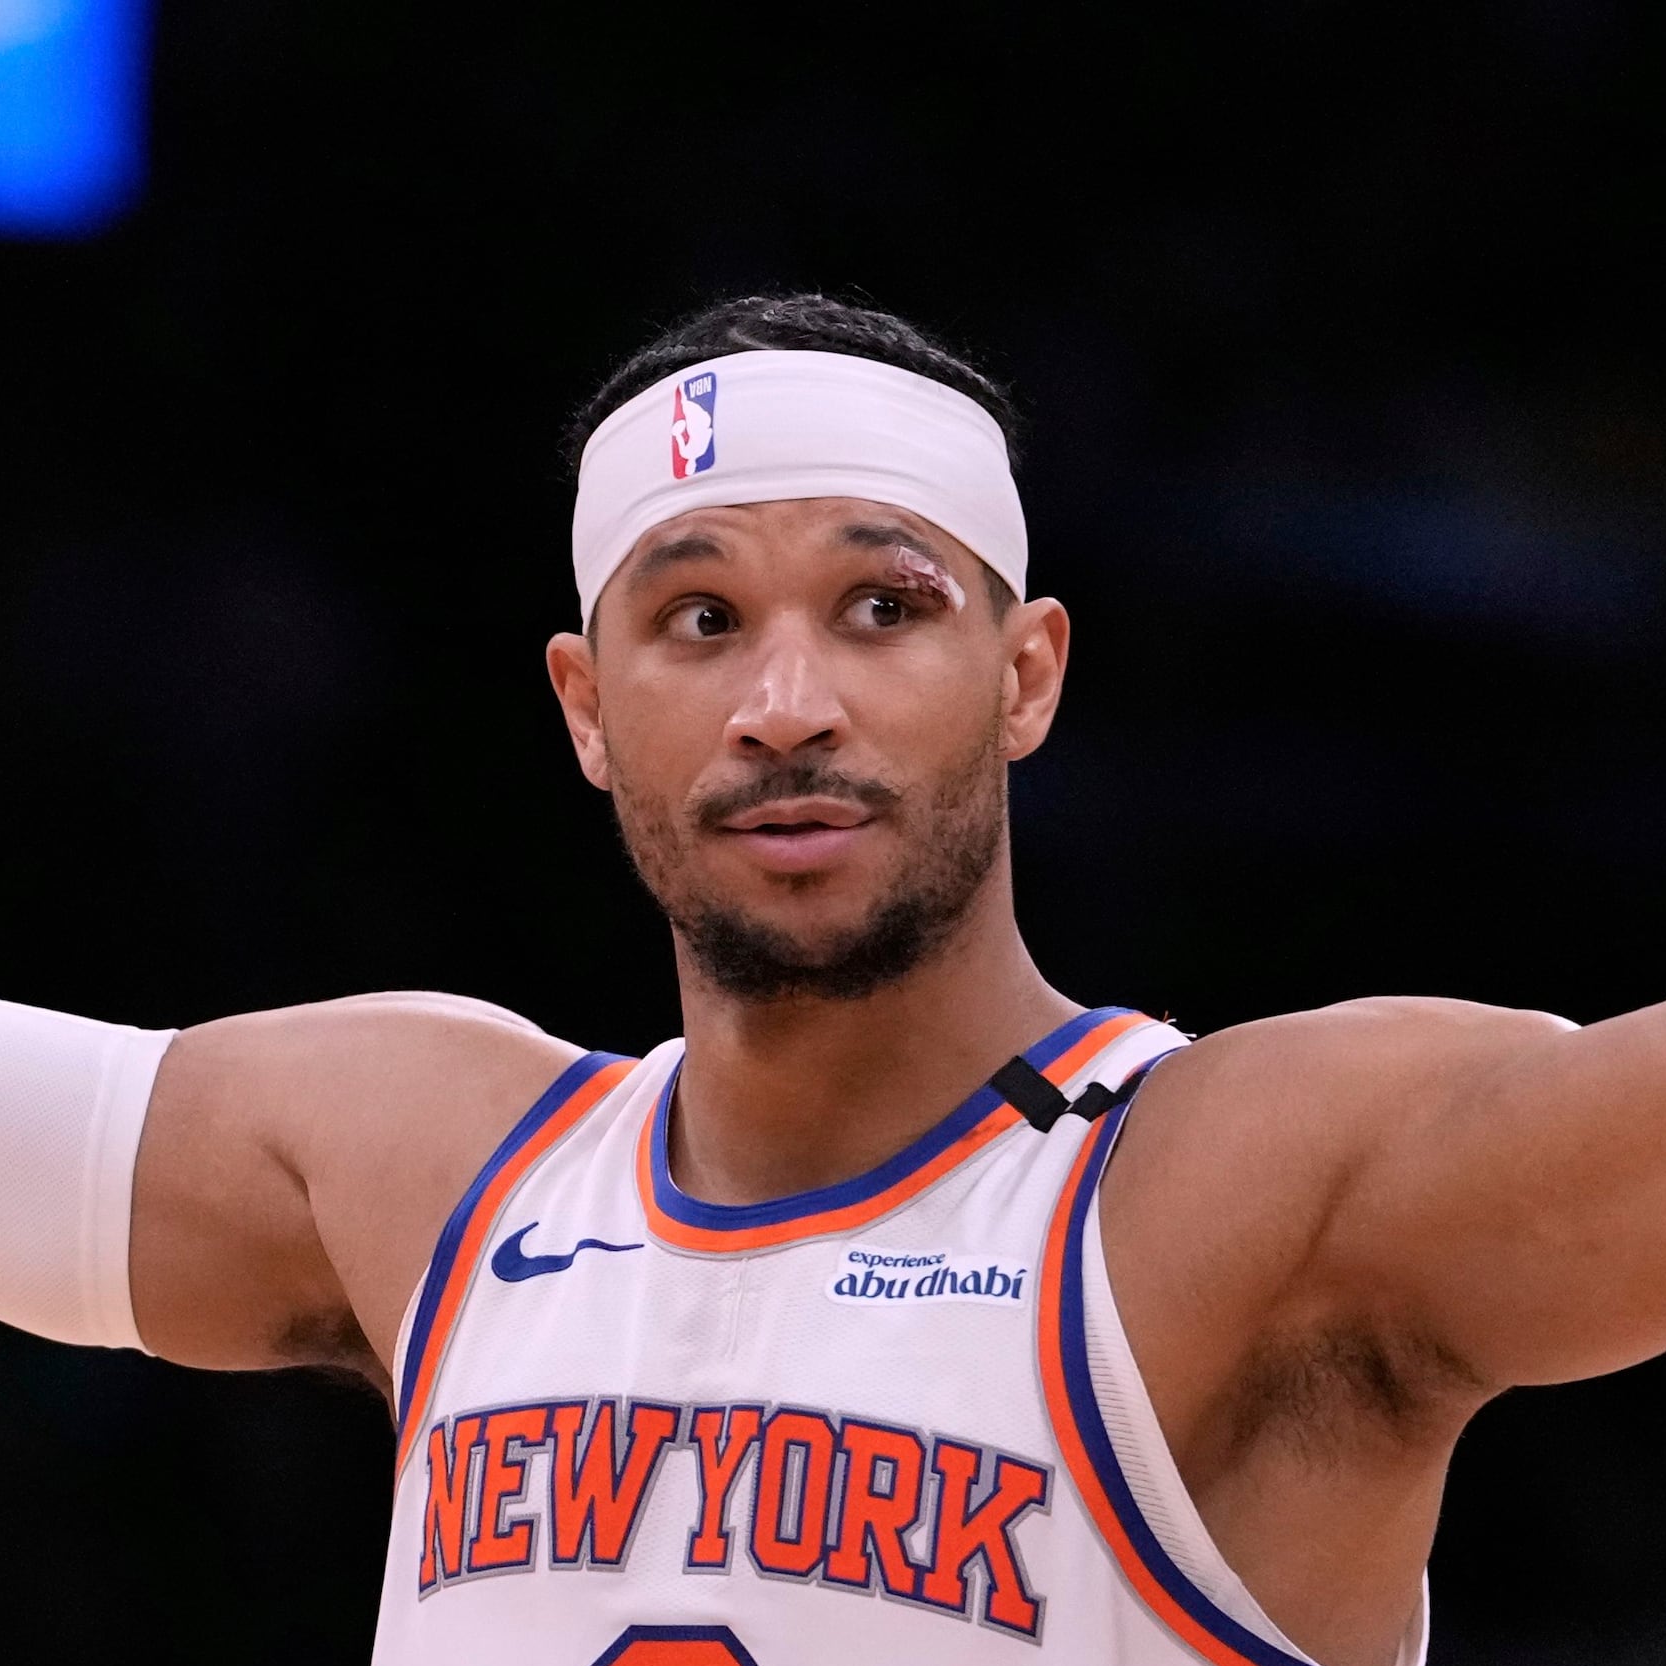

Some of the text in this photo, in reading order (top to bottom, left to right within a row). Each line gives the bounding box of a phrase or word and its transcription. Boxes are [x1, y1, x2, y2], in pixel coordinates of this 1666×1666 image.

[689, 376, 712, 398] NBA
[848, 1250, 946, 1268] experience
[834, 1265, 1027, 1299] abu dhabi
[419, 1396, 1055, 1646] NEW YORK
